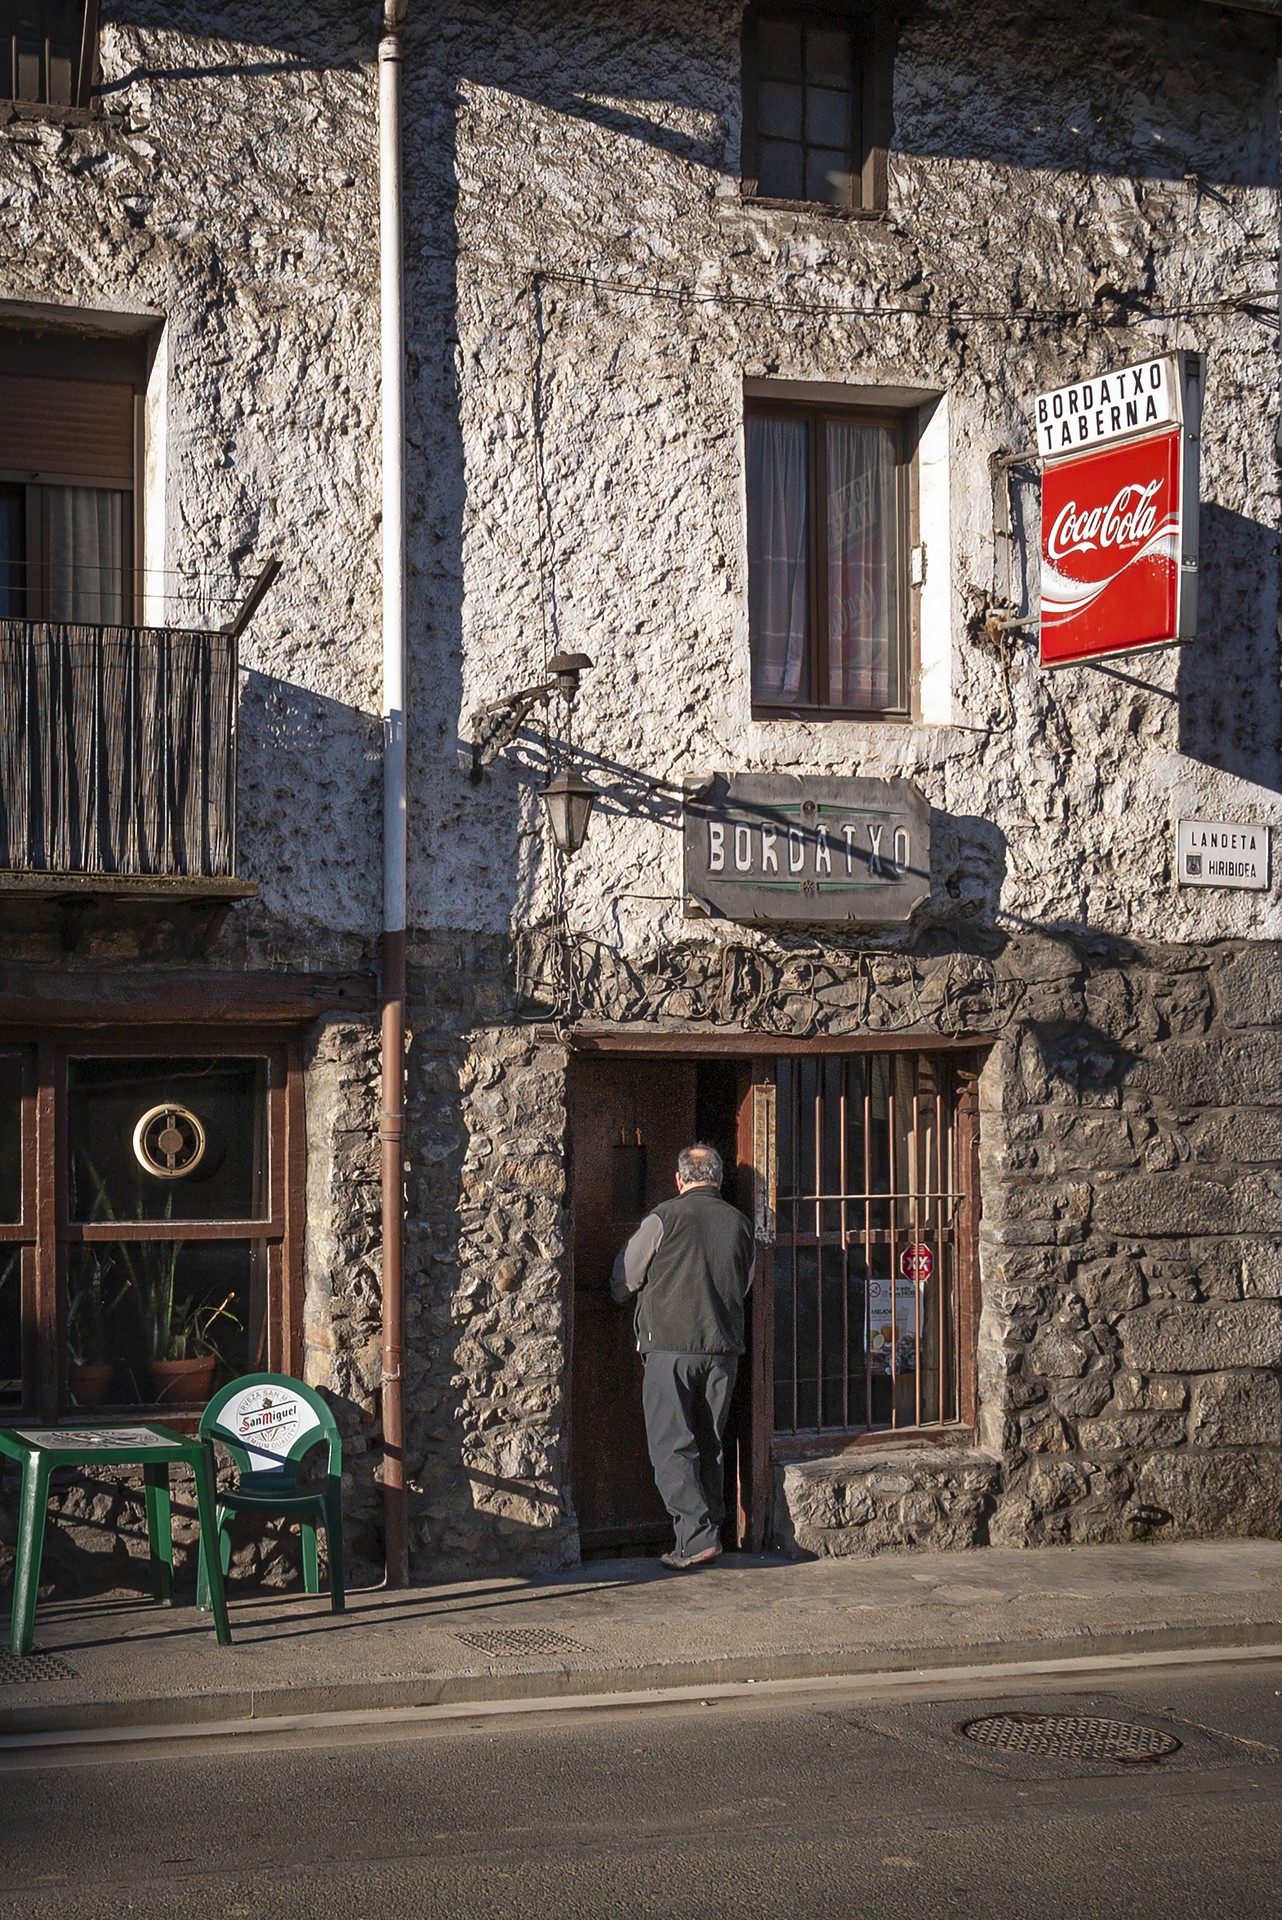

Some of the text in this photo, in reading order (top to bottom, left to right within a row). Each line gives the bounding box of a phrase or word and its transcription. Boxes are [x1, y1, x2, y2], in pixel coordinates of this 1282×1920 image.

[1038, 363, 1162, 424] BORDATXO
[1044, 395, 1158, 450] TABERNA
[1048, 478, 1165, 560] Coca-Cola
[707, 821, 910, 874] BORDATXO
[1191, 831, 1256, 850] LANDETA
[1208, 860, 1256, 877] HIRIBIDEA
